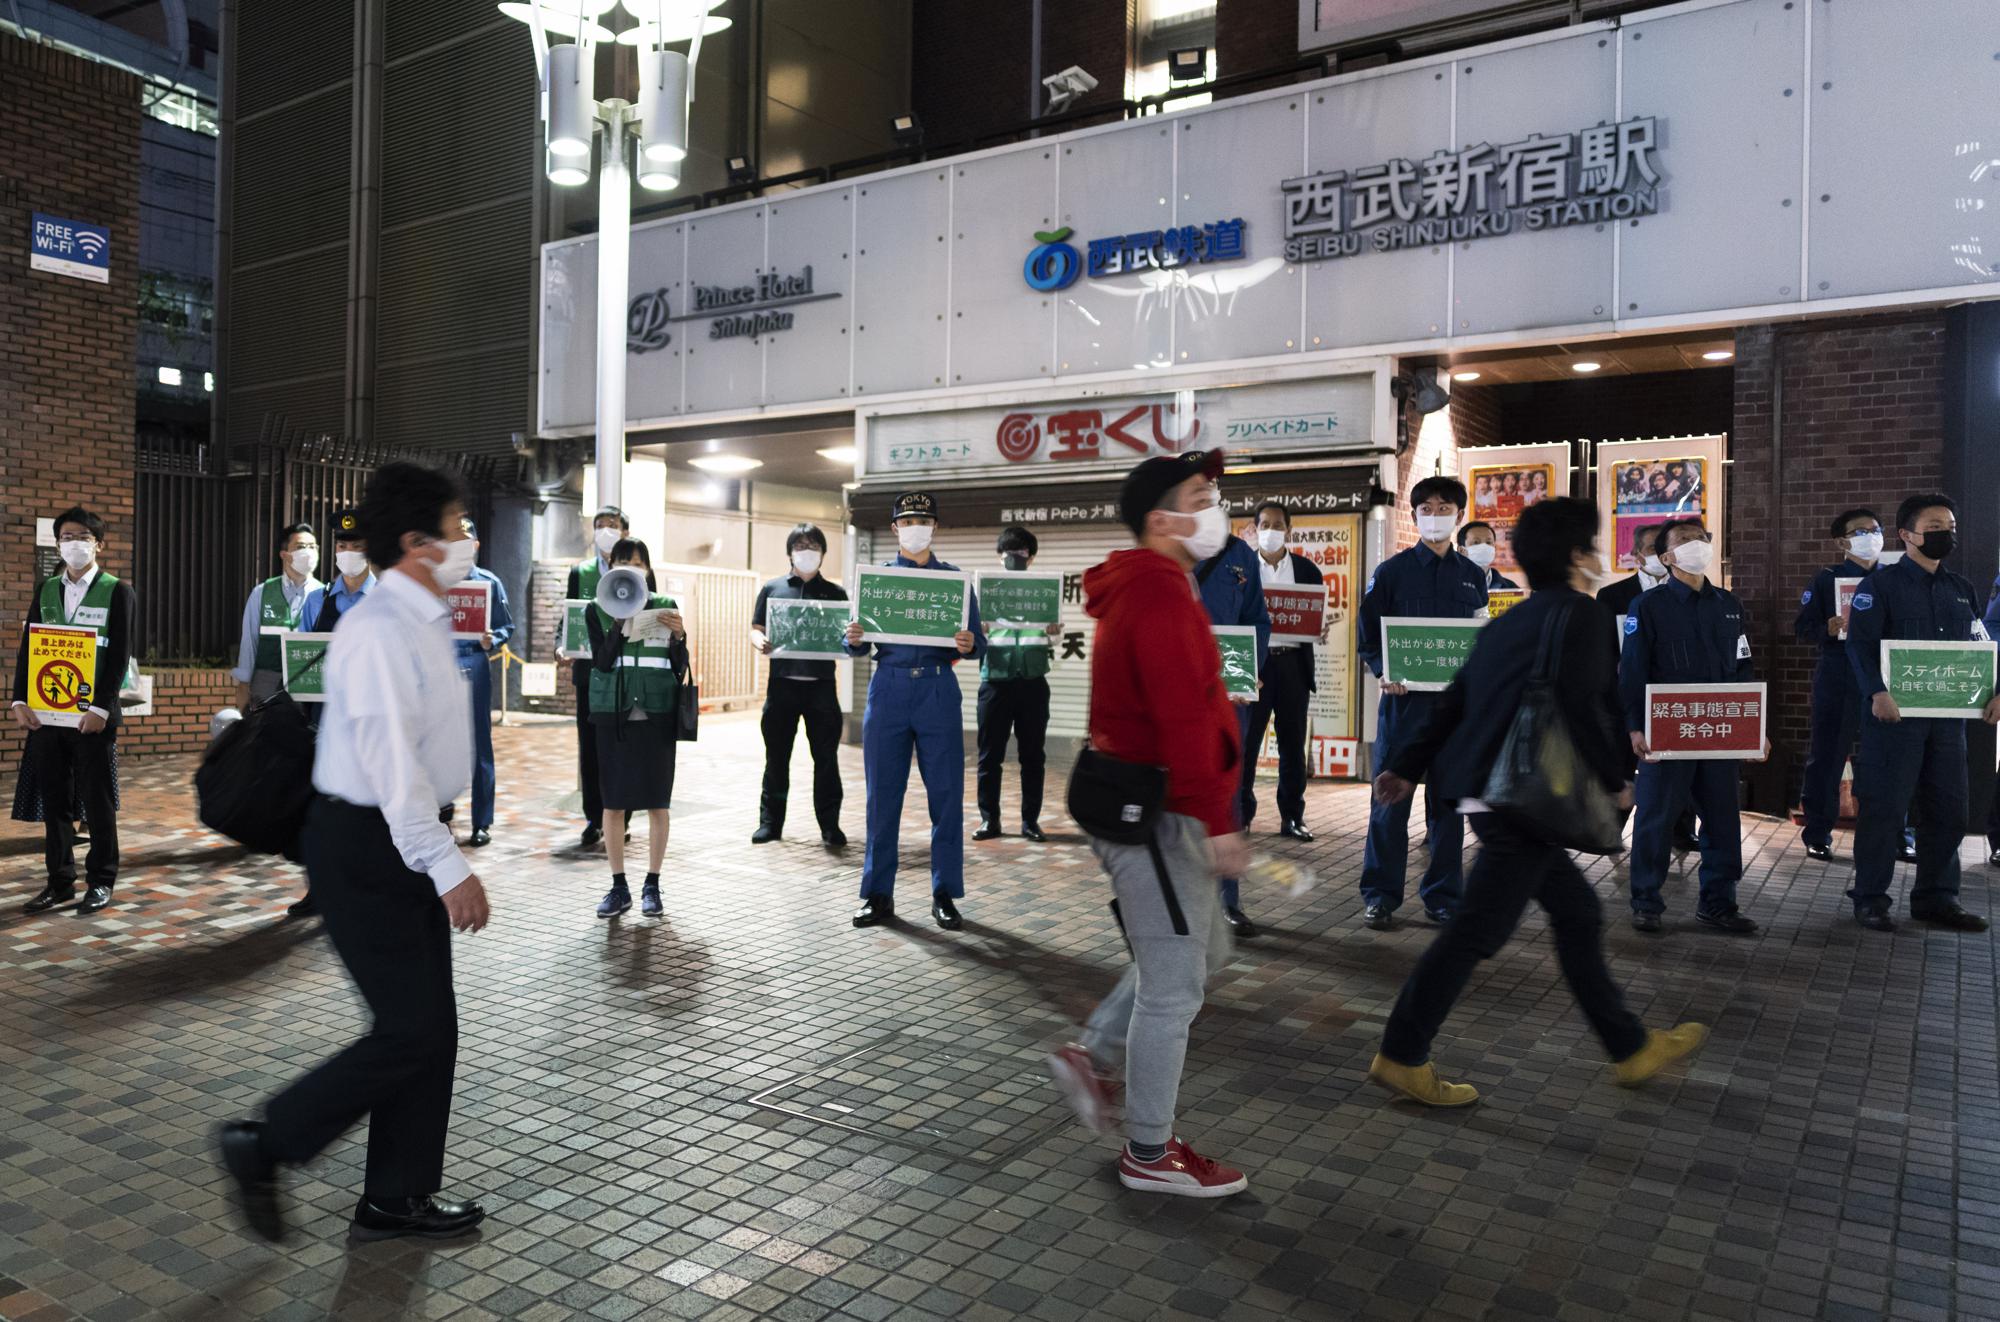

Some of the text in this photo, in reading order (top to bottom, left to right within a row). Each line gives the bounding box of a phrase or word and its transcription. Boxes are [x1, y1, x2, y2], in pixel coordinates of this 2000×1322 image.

[1281, 116, 1661, 240] 西武新宿駅
[36, 220, 73, 241] FREE
[1284, 190, 1659, 263] SEIBU SHINJUKU STATION
[36, 235, 72, 254] Wi-Fi
[1087, 218, 1247, 278] 西武鉄道
[692, 264, 814, 311] Prince Hotel
[709, 310, 794, 340] Shinjuku
[1047, 403, 1201, 460] 宝くじ
[901, 494, 931, 506] TOKYO
[1051, 506, 1088, 519] PePe
[1090, 504, 1119, 519] 大黒
[861, 587, 962, 604] 外出が必要かどうか
[872, 605, 949, 621] もう一度検討を
[1389, 638, 1477, 649] 外出が必要かど
[33, 648, 91, 658] 止めてください
[1901, 665, 1982, 678] ステイホーム
[1652, 702, 1760, 718] 緊急事態宣言
[1679, 722, 1732, 738] 発令中
